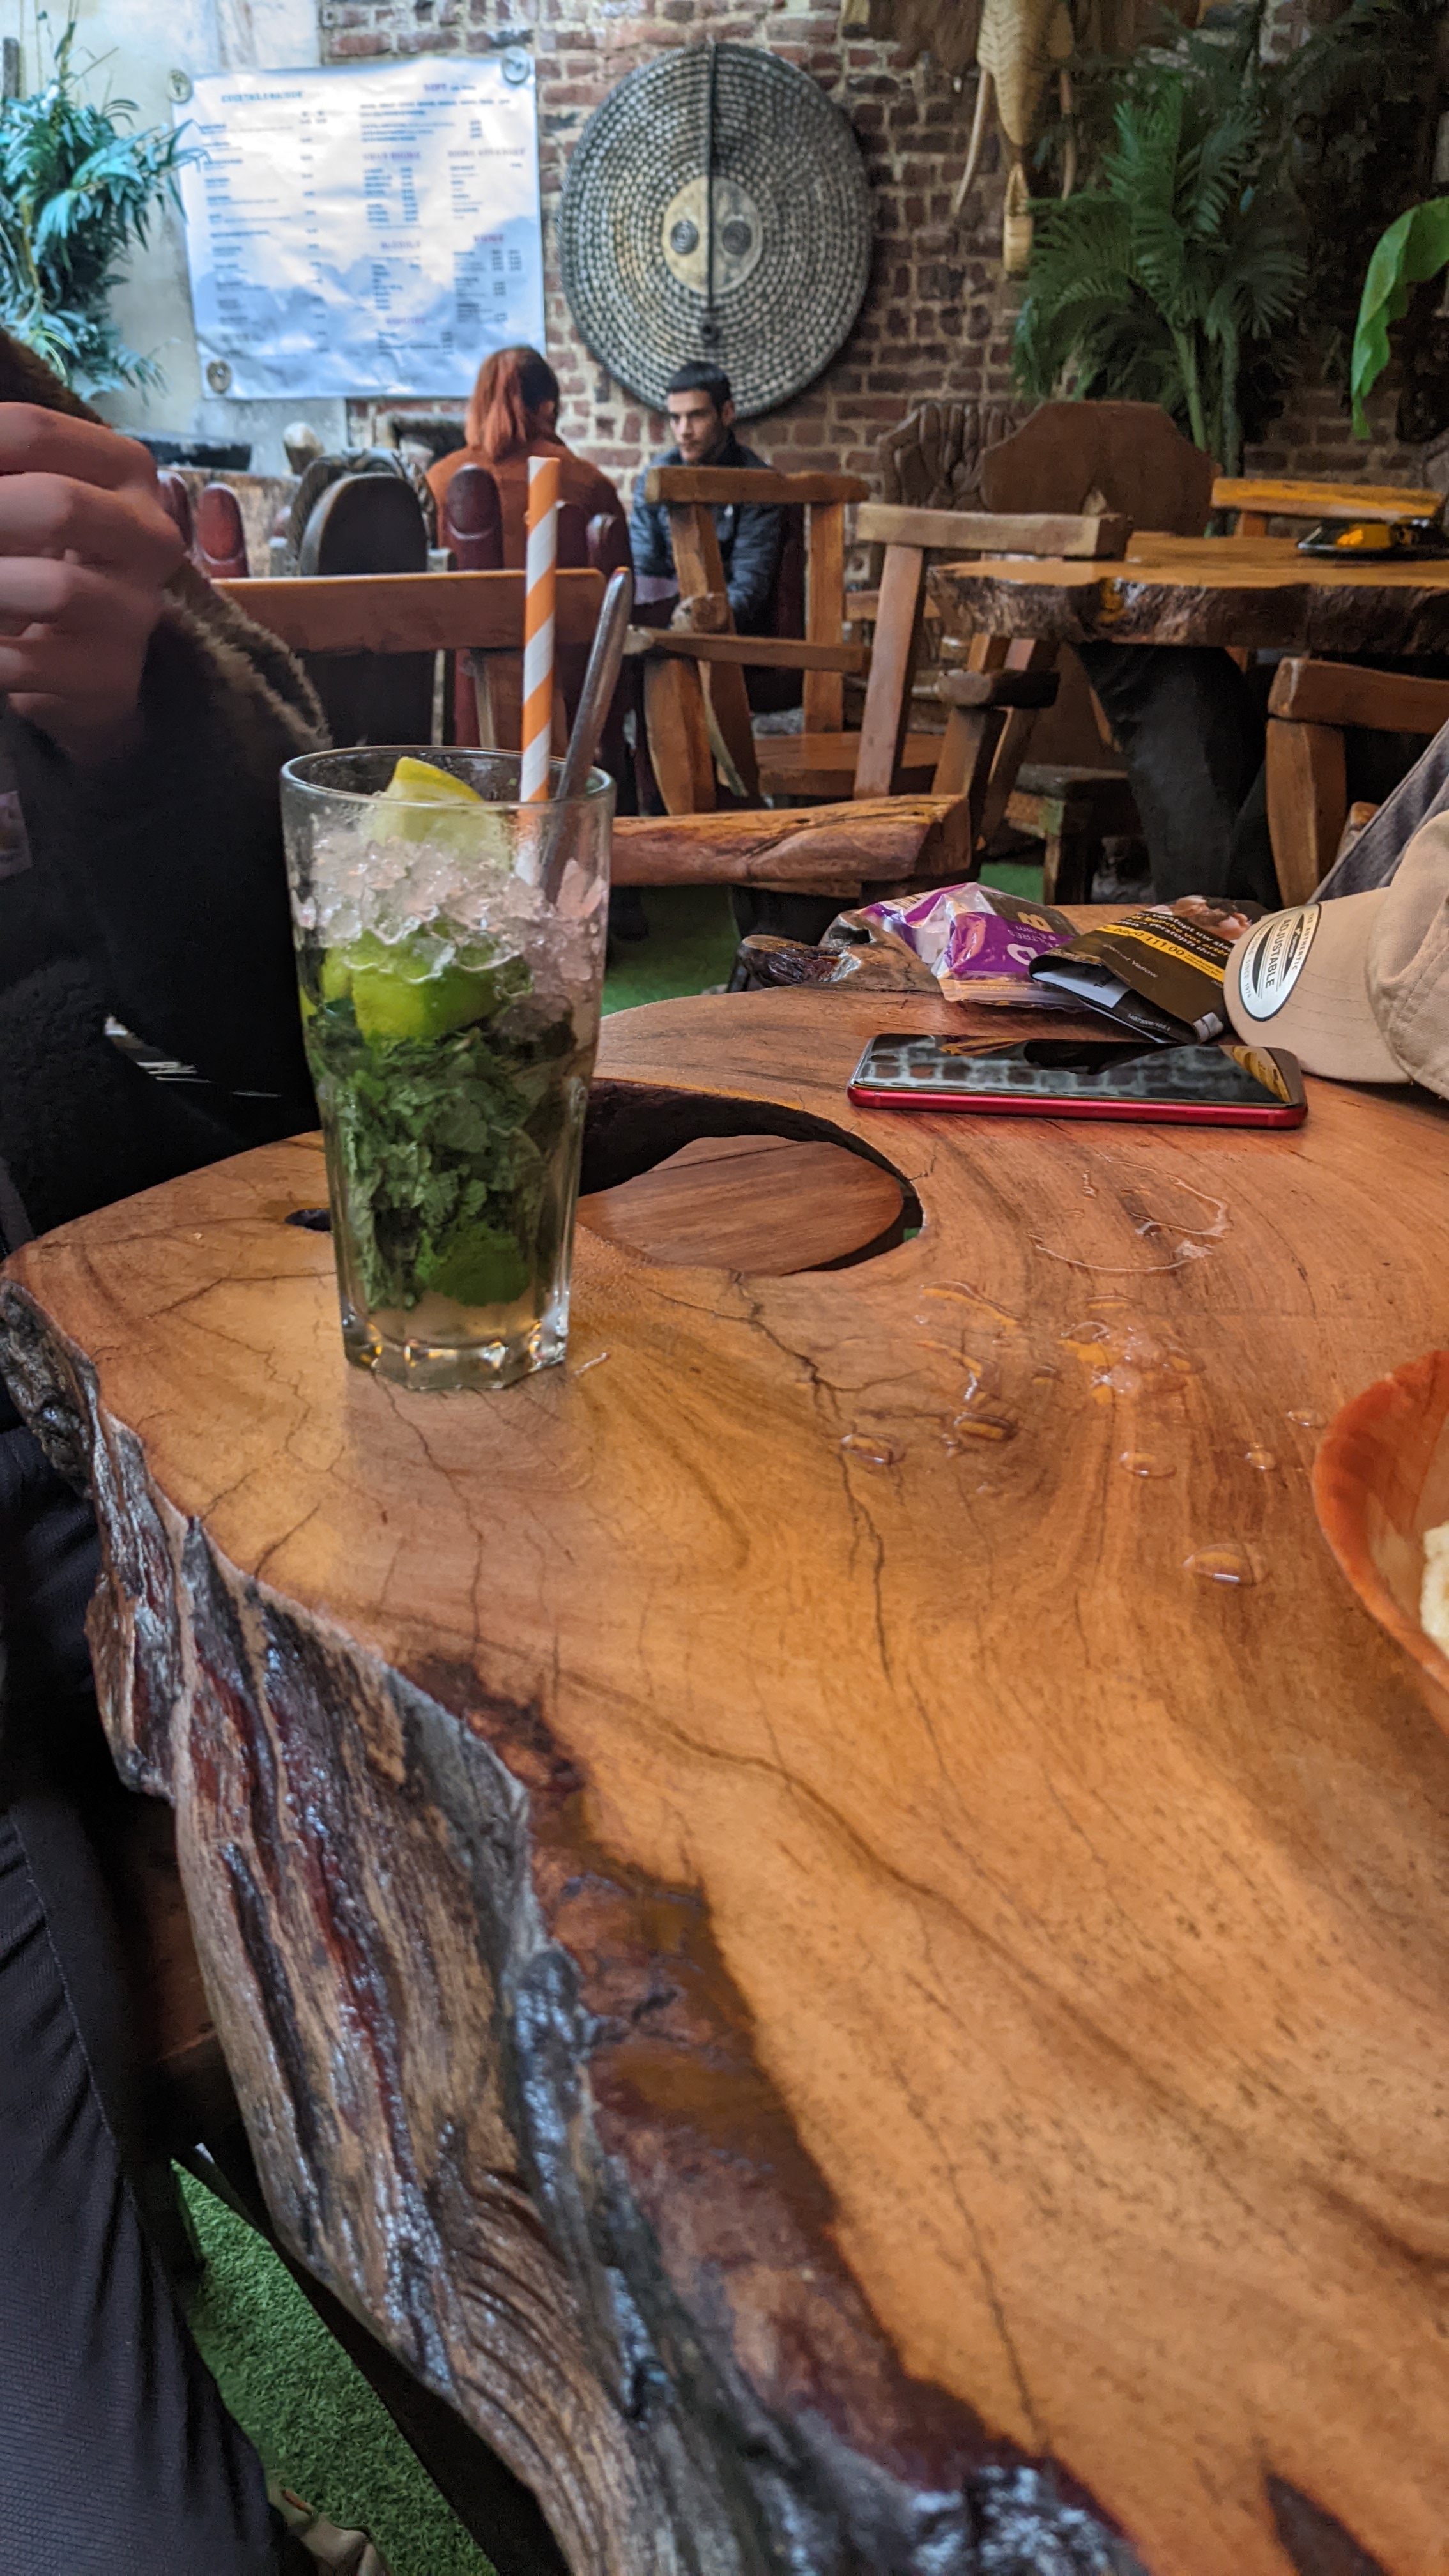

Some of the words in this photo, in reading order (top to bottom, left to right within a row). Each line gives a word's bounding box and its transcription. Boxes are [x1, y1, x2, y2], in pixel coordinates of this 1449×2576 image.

[1008, 929, 1060, 948] ILTRES
[1146, 937, 1168, 948] 111
[1168, 946, 1185, 956] 00
[1265, 919, 1292, 989] ADJUSTABLE
[1292, 927, 1310, 970] AUTHENTIC
[1131, 960, 1158, 978] Yellow
